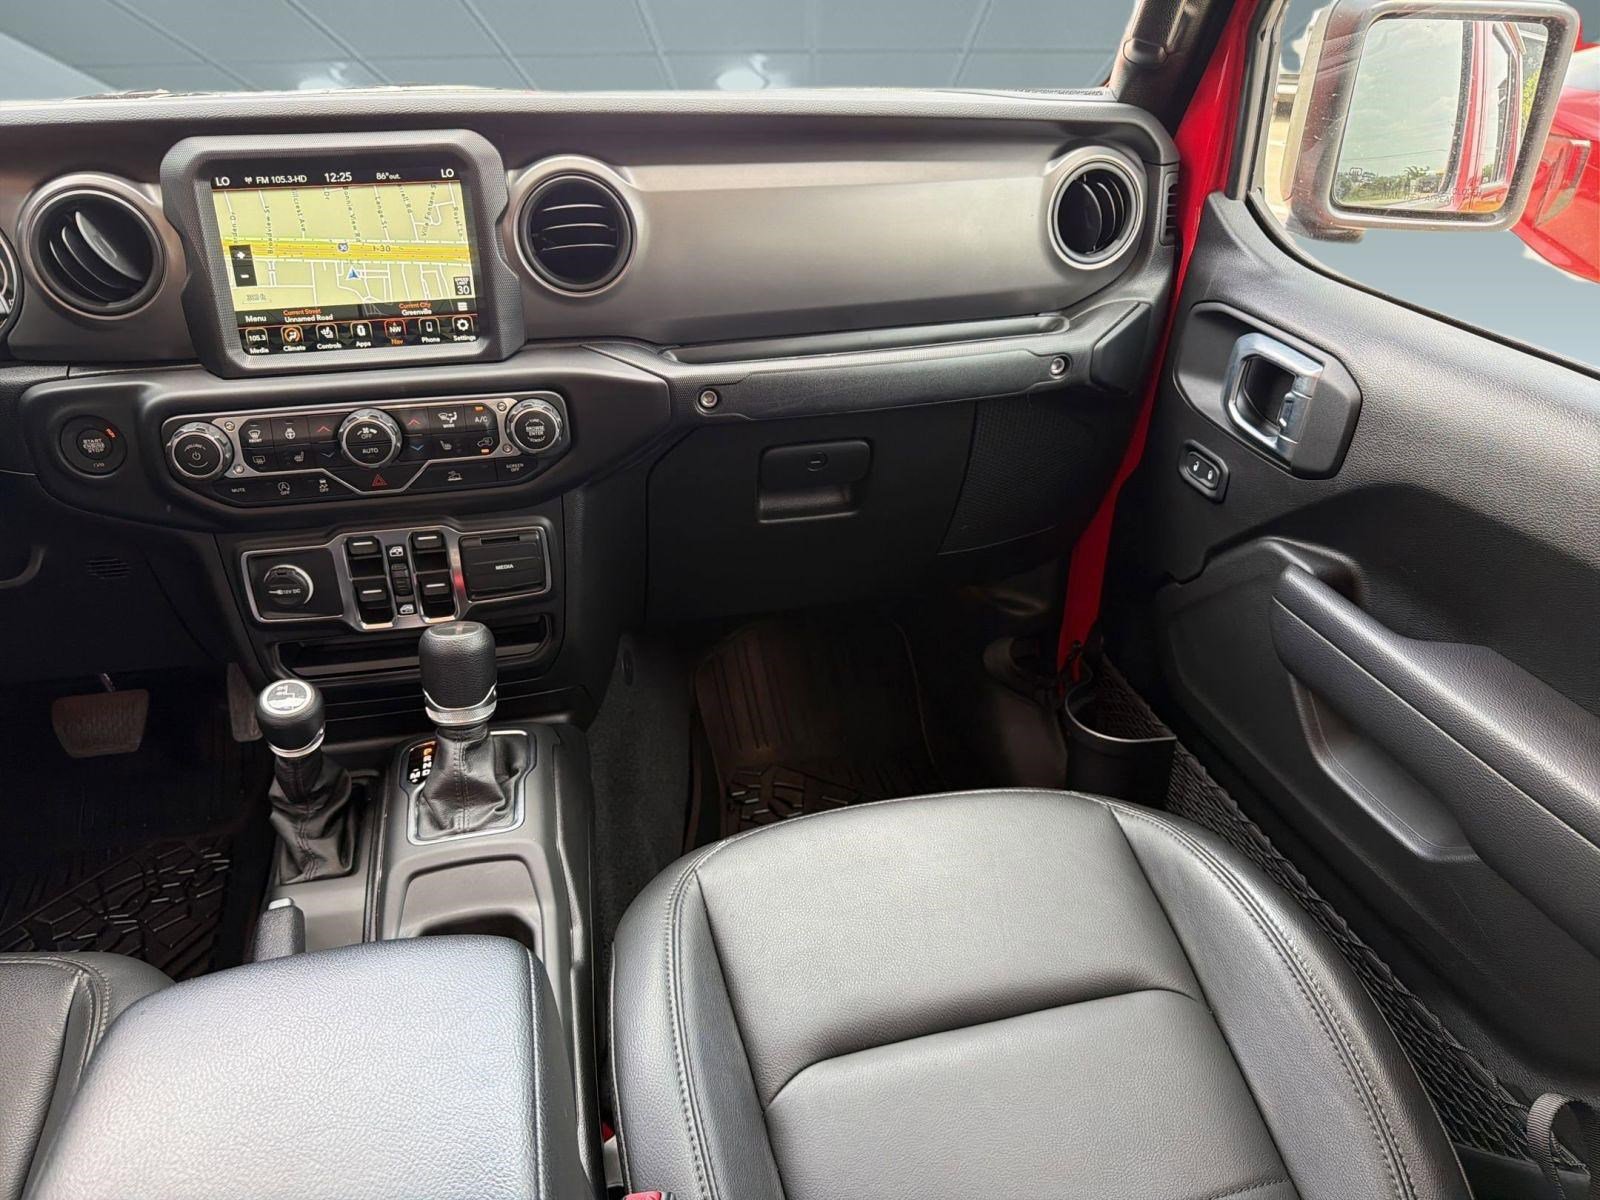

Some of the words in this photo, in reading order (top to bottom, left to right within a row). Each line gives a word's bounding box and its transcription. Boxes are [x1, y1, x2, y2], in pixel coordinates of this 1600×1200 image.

[324, 172, 353, 183] 12:25
[441, 169, 455, 178] LO
[215, 177, 231, 187] LO
[256, 176, 270, 185] FM
[271, 175, 308, 184] 105.3-HD
[457, 285, 470, 295] 30
[245, 315, 267, 323] Menu
[284, 315, 316, 323] Unnamed
[249, 347, 270, 355] Media
